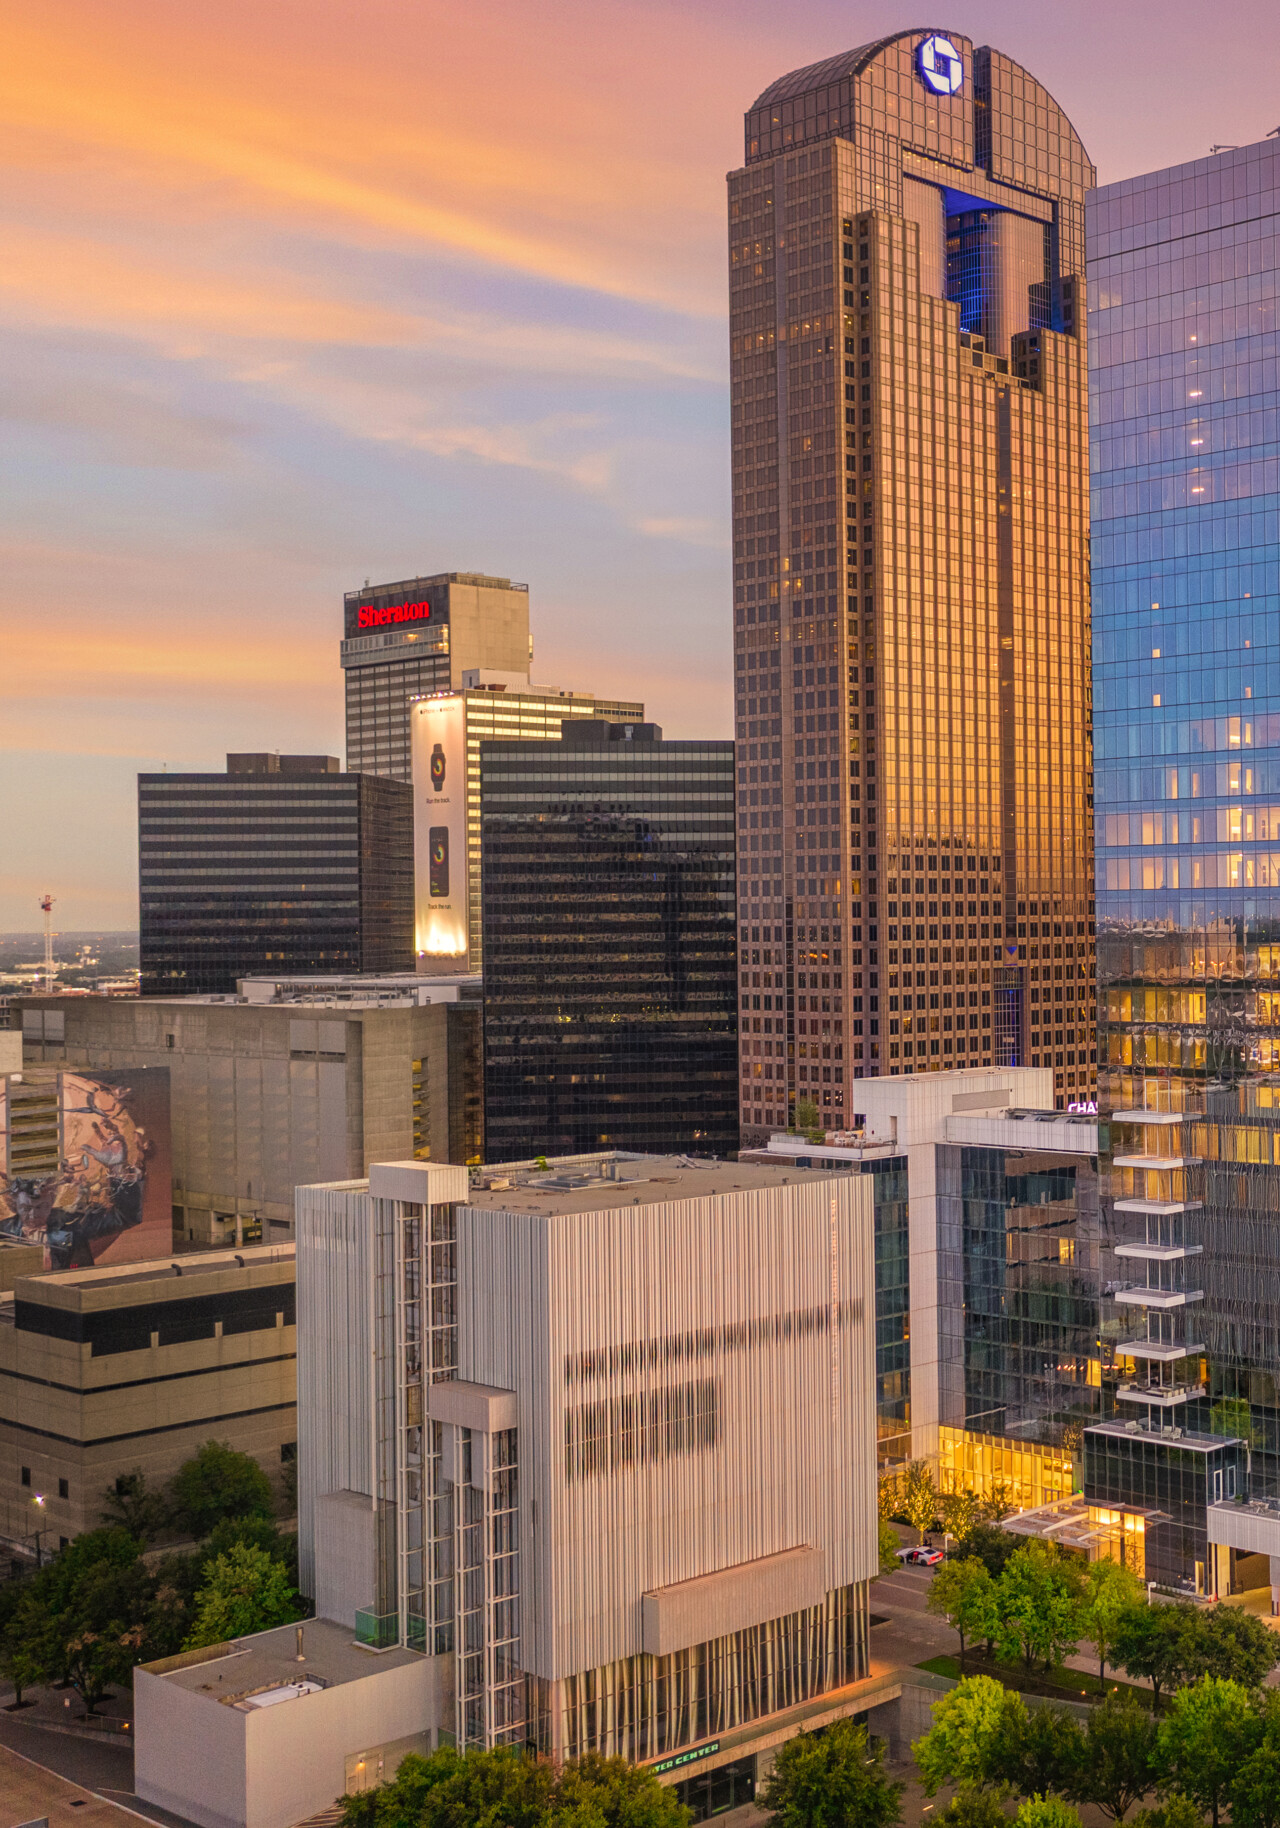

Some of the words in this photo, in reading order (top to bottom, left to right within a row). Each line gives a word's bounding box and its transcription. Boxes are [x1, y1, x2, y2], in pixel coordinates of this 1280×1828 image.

[358, 601, 429, 628] Sheraton
[1068, 1100, 1098, 1115] CHA
[675, 1743, 719, 1765] CENTER
